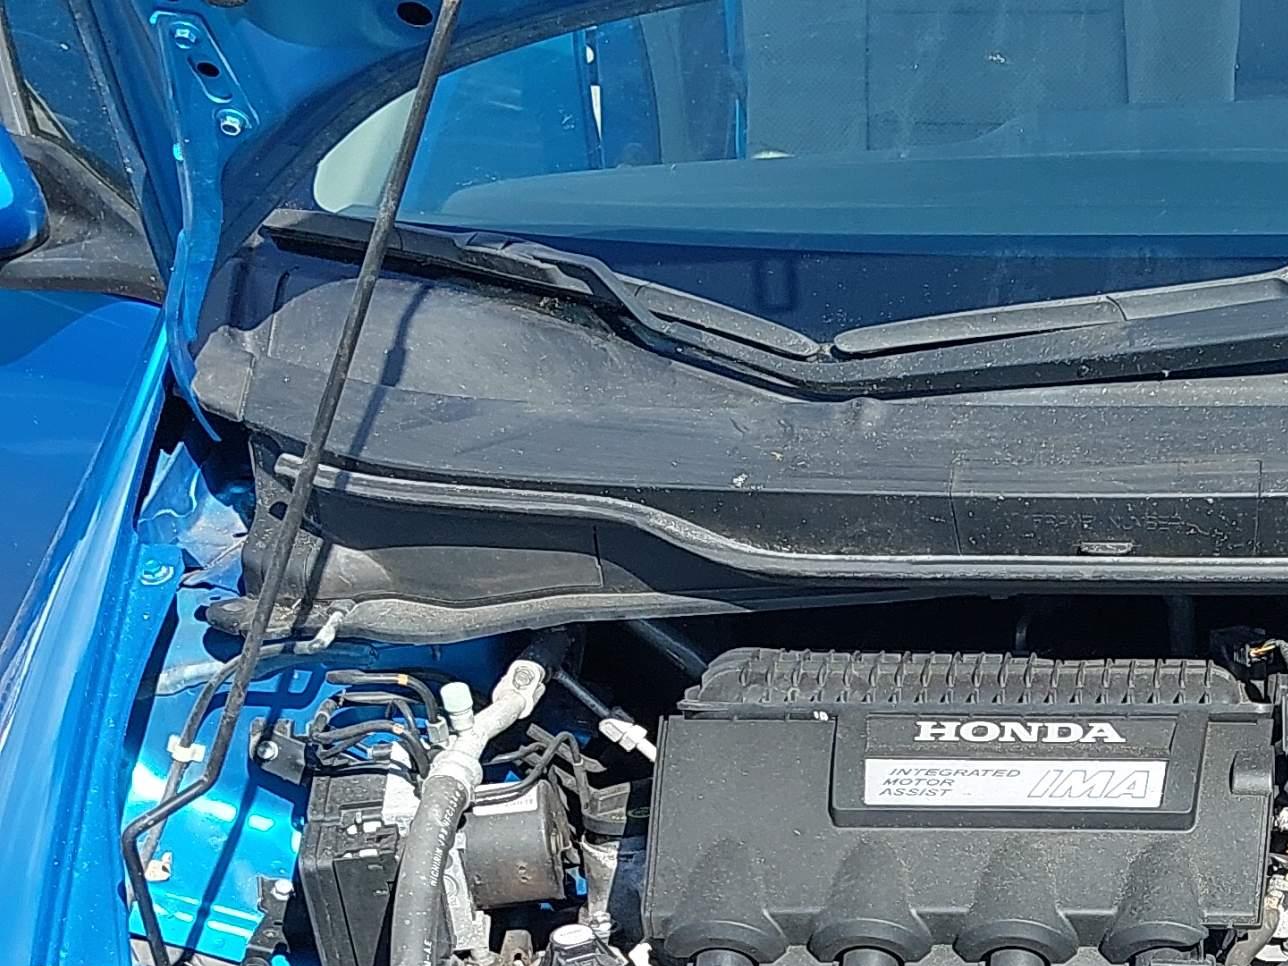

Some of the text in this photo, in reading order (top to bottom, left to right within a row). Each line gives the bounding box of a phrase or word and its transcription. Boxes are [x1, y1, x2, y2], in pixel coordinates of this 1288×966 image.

[913, 720, 1127, 744] HONDA
[882, 778, 956, 787] MOTOR
[889, 768, 1150, 799] INTEGRATED IMA
[879, 787, 953, 797] ASSIST
